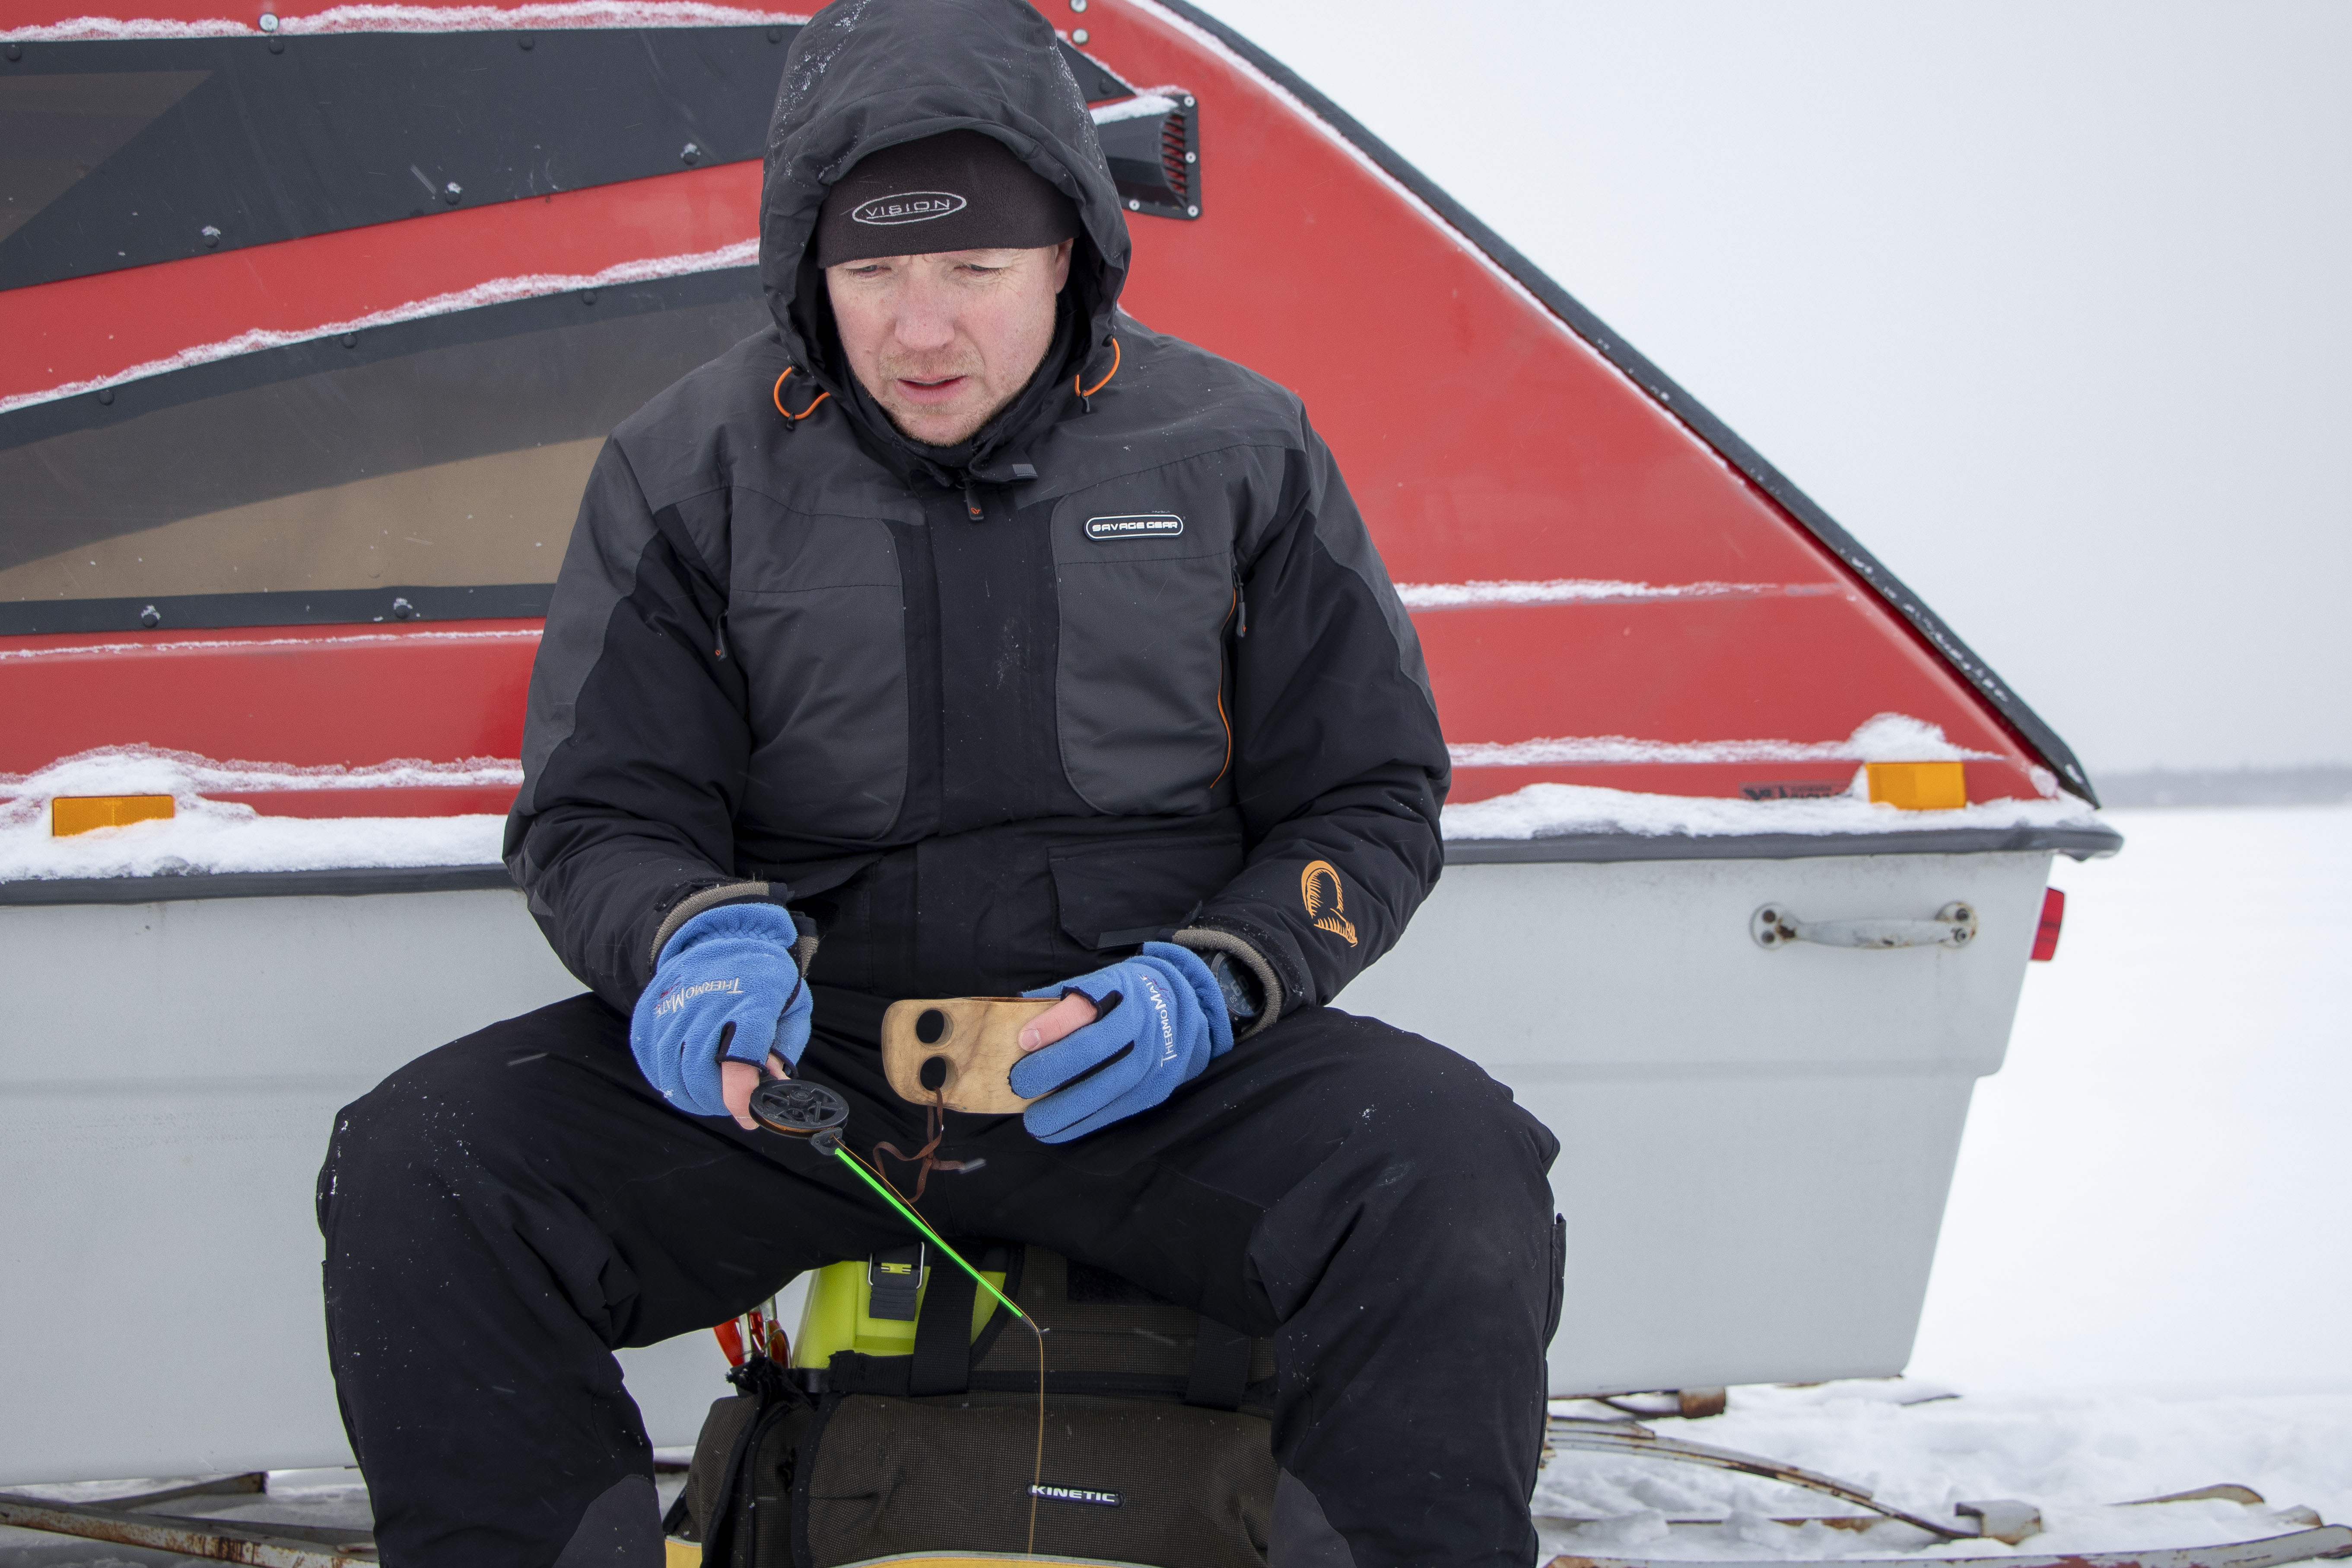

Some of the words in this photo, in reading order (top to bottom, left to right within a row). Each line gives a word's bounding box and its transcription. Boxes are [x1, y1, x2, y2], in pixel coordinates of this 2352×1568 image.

[865, 199, 950, 216] VISION
[1092, 522, 1145, 532] SAVAGE
[1031, 1485, 1116, 1502] KINETIC
